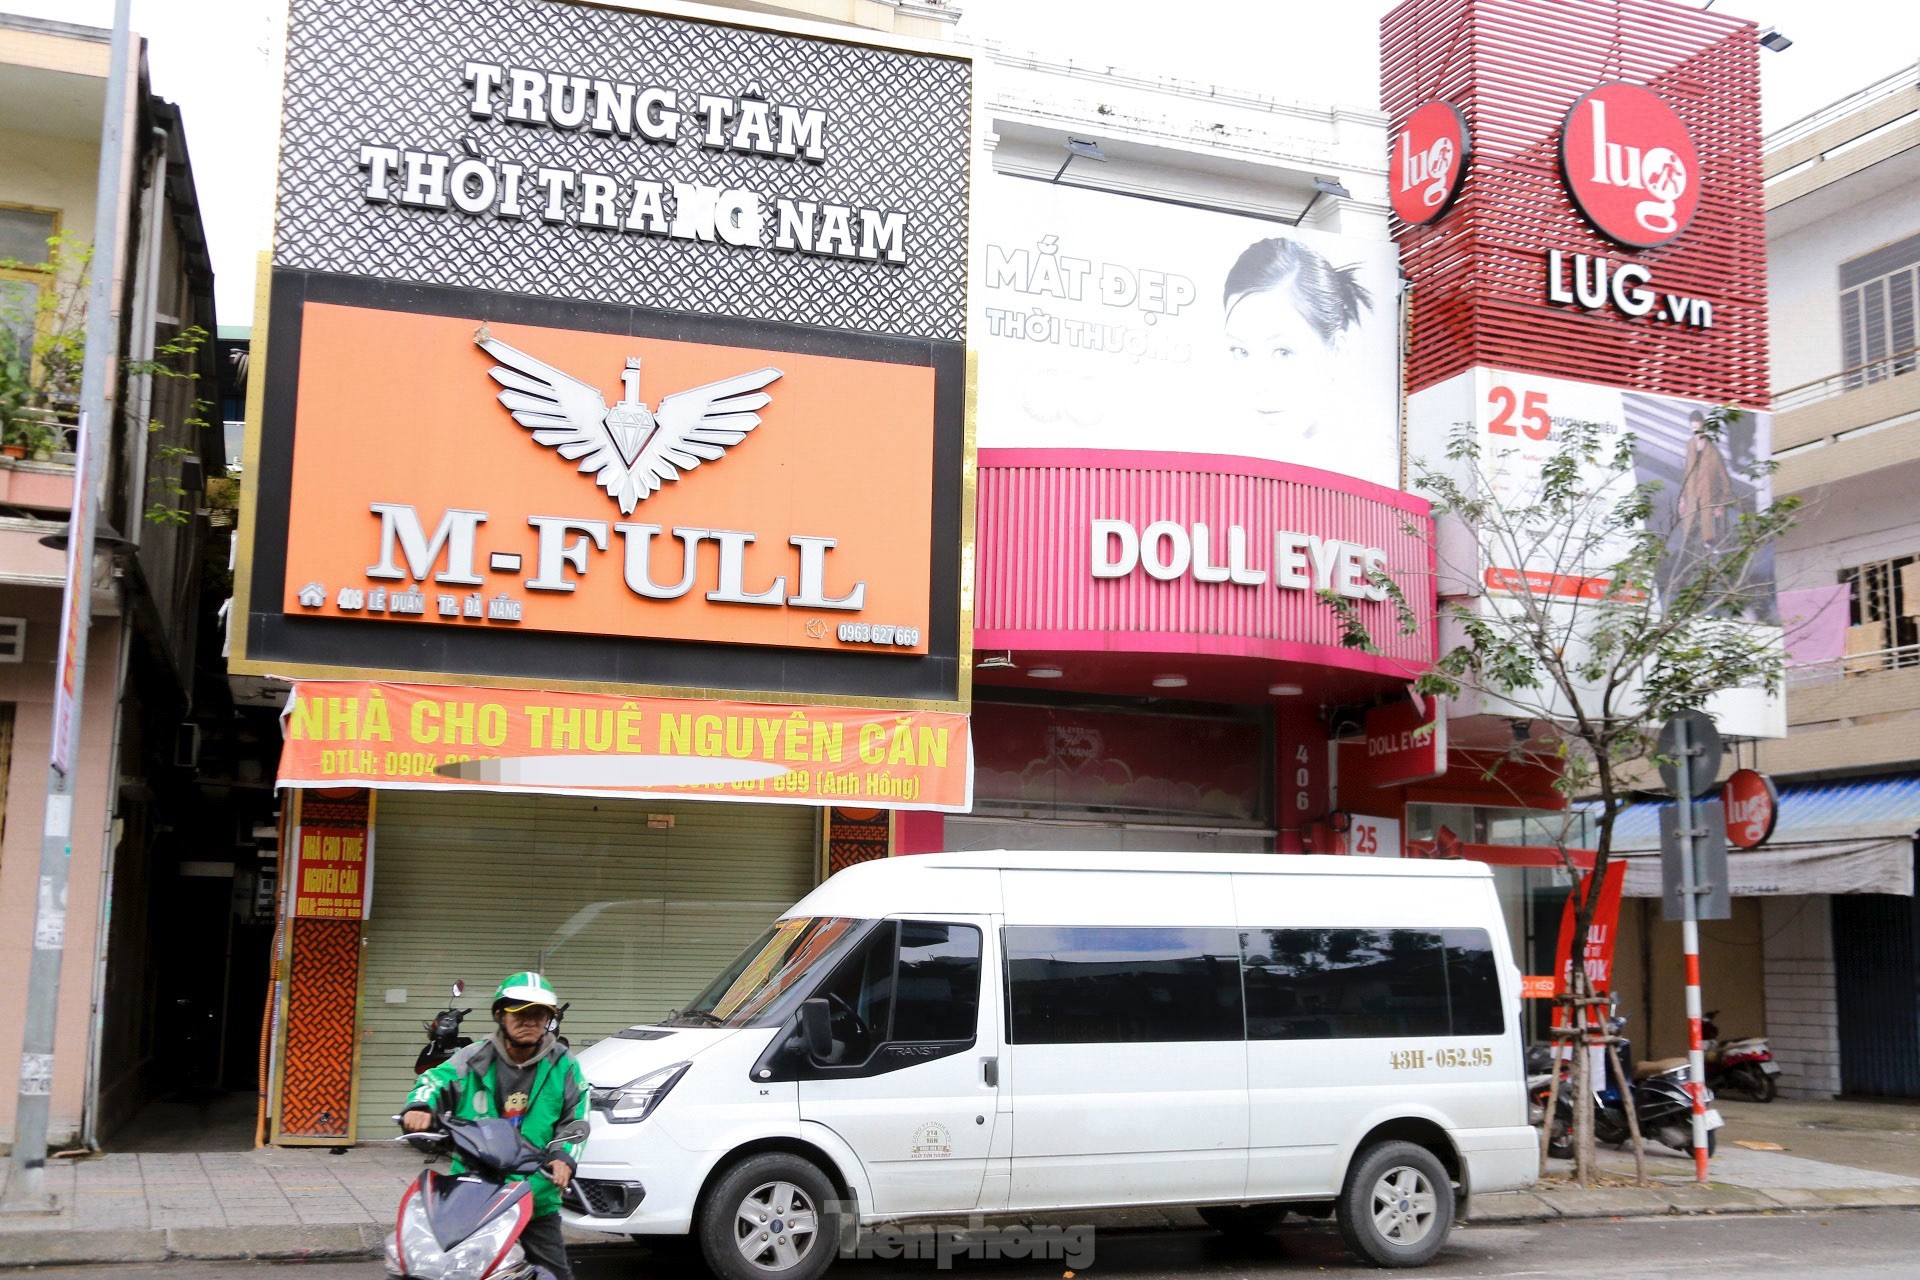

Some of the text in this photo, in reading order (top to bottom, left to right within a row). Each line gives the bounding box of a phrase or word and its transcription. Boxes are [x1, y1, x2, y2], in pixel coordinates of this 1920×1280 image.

[464, 61, 826, 163] TRUNG TÂM
[1399, 130, 1454, 207] lug
[1590, 98, 1687, 233] lug
[359, 135, 908, 265] THỜI TRANG NAM
[985, 234, 1196, 326] MẮT ĐẸP
[1549, 249, 1713, 329] LUG.vn
[985, 307, 1060, 344] THỜI
[1487, 385, 1552, 441] 25
[365, 502, 866, 611] M-FULL
[1091, 519, 1389, 602] DOLL EYES
[367, 585, 387, 612] LÊ
[837, 622, 920, 647] 0963 627 669
[290, 688, 949, 768] NHÀ CHO THUÊ NGUYÊN CĂN
[1368, 731, 1431, 757] DOLL EYES
[321, 750, 379, 775] ĐTLH:
[385, 751, 437, 778] 0904
[816, 769, 861, 796] (Anh
[866, 768, 920, 801] Hồng)
[1296, 744, 1309, 811] 406
[1356, 825, 1377, 854] 25
[1726, 782, 1769, 841] lug
[323, 836, 341, 861] CHO
[887, 1046, 942, 1057] TRANSIT
[1389, 1047, 1493, 1070] 43H-052.95
